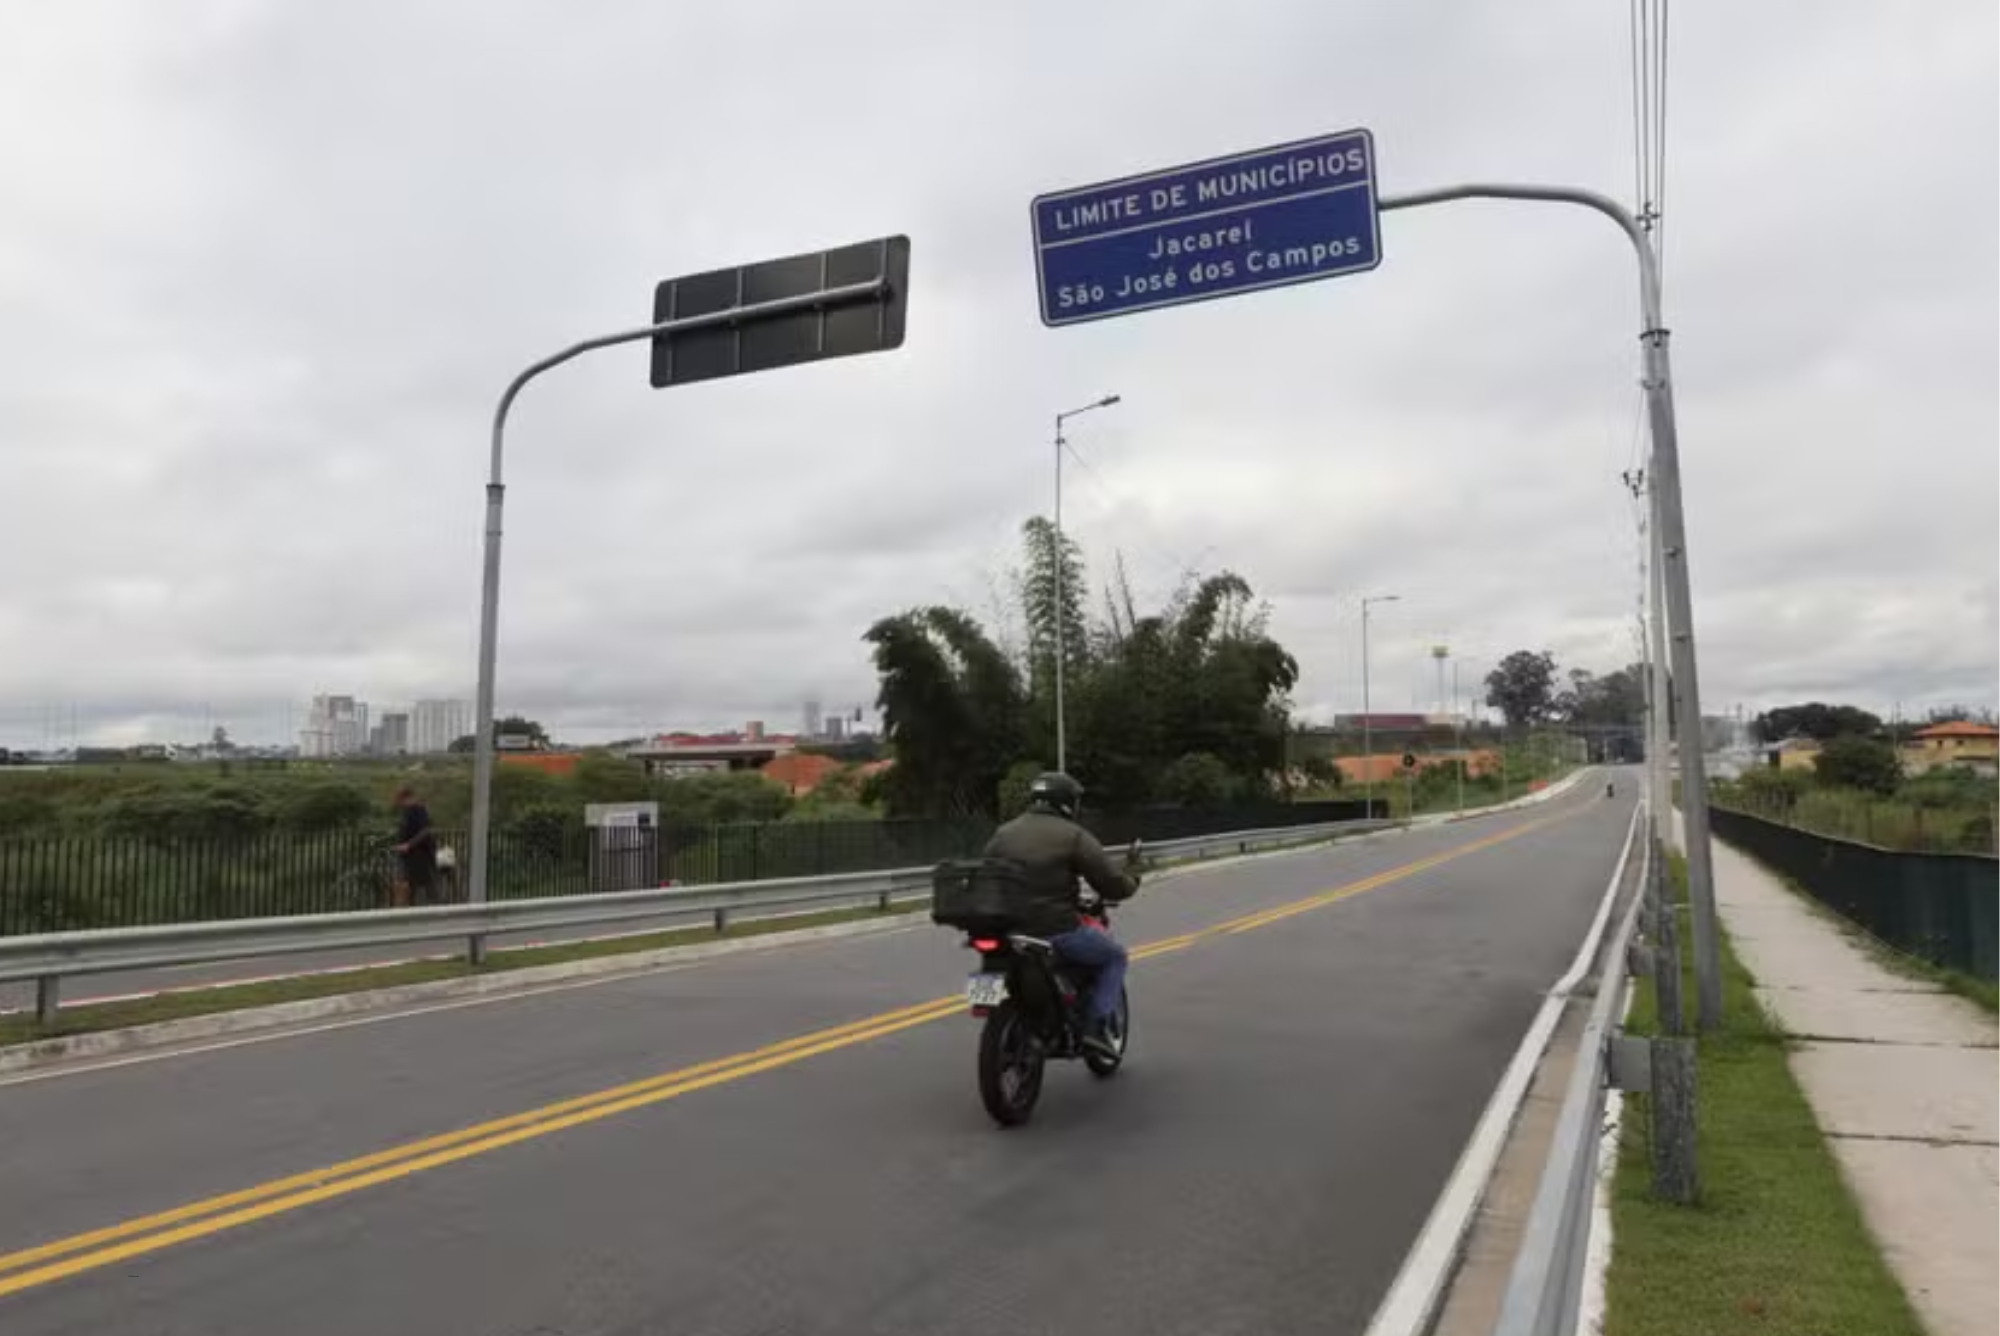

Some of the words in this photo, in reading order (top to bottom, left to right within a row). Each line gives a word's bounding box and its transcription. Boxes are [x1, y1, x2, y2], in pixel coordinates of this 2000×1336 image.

[1056, 197, 1141, 230] LIMITE
[1152, 186, 1187, 208] DE
[1198, 149, 1364, 202] MUNICÍPIOS
[1059, 285, 1104, 308] São
[1116, 268, 1177, 297] José
[1189, 256, 1235, 283] dos
[1247, 237, 1360, 272] Campos
